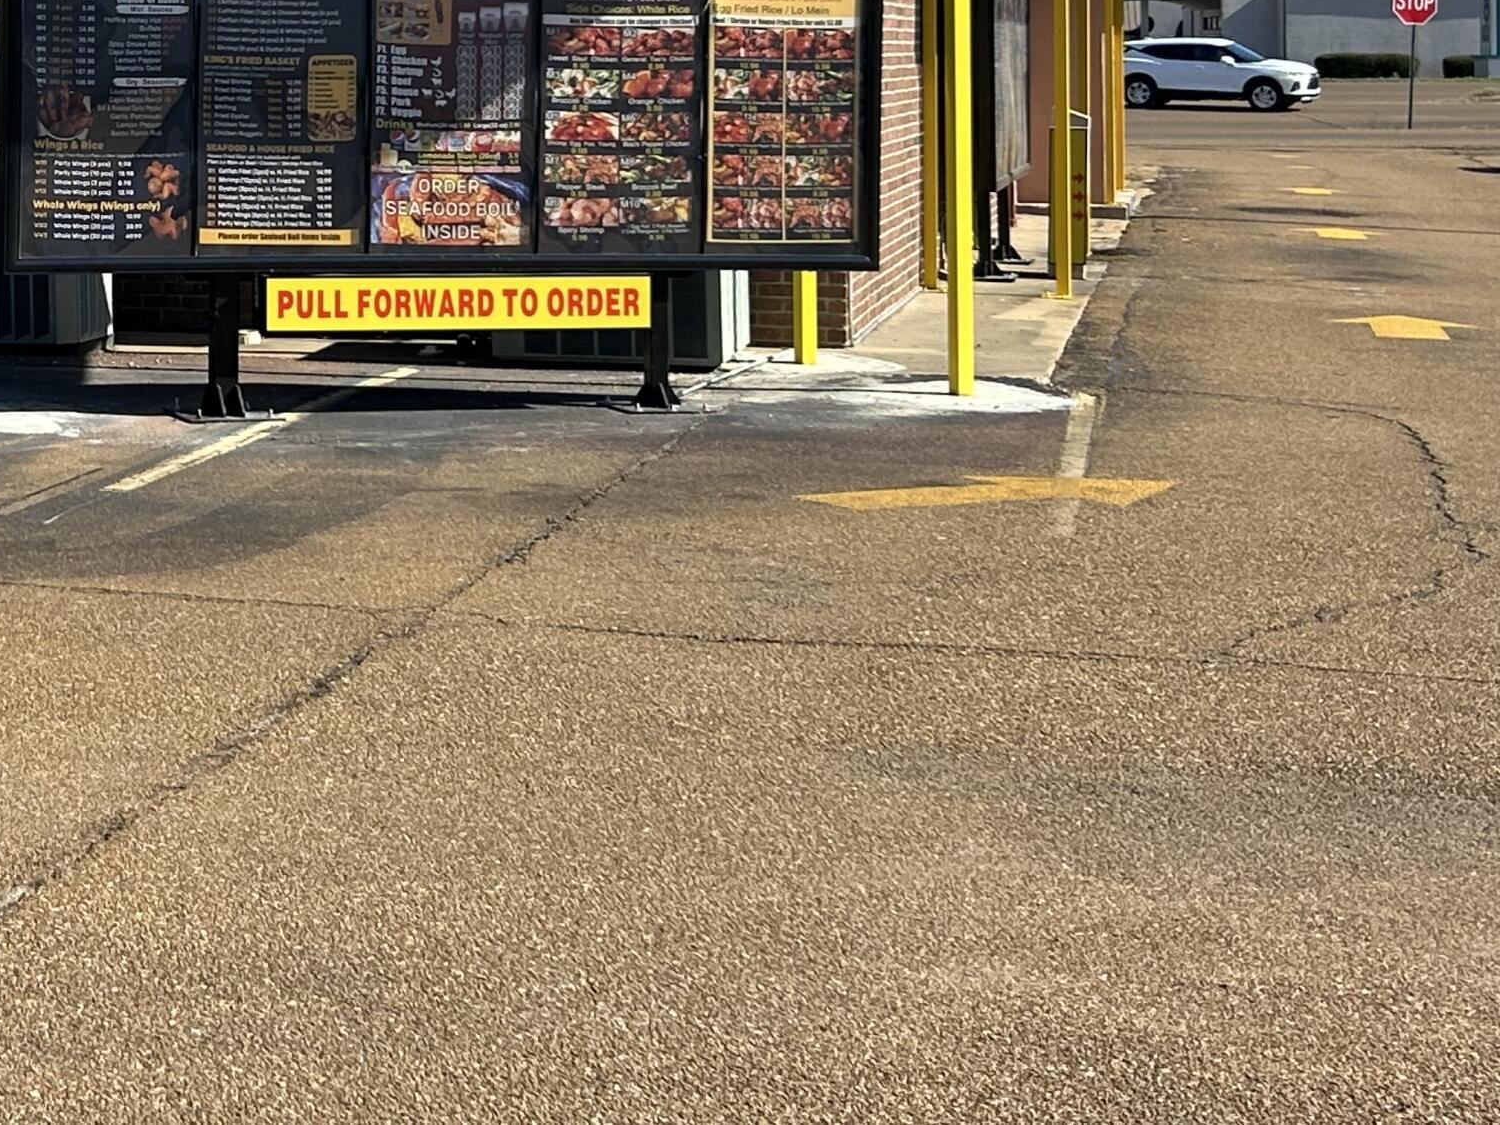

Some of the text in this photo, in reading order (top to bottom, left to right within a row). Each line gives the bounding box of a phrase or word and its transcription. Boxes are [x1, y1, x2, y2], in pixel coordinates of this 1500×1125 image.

[566, 4, 589, 14] Side
[636, 4, 667, 14] White
[668, 4, 691, 14] Rice
[734, 4, 759, 16] Fried
[761, 4, 783, 16] Rice
[791, 4, 805, 16] Lo
[805, 4, 830, 16] Mein
[390, 54, 428, 66] Chicken
[391, 65, 424, 77] Shrimp
[391, 85, 420, 97] House
[390, 95, 412, 107] Pork
[375, 118, 414, 130] Drinks
[34, 140, 68, 151] Wings
[80, 140, 104, 151] Rice
[418, 178, 480, 194] ORDER
[33, 200, 160, 212] Whole Wings (Wings only)
[385, 200, 517, 217] SEAFOOD BOIL
[620, 198, 641, 208] M10
[218, 232, 240, 241] Please
[241, 232, 258, 241] order
[260, 232, 286, 241] Seafood
[420, 224, 482, 240] INSIDE
[277, 287, 640, 319] PULL FORWARD TO ORDER
